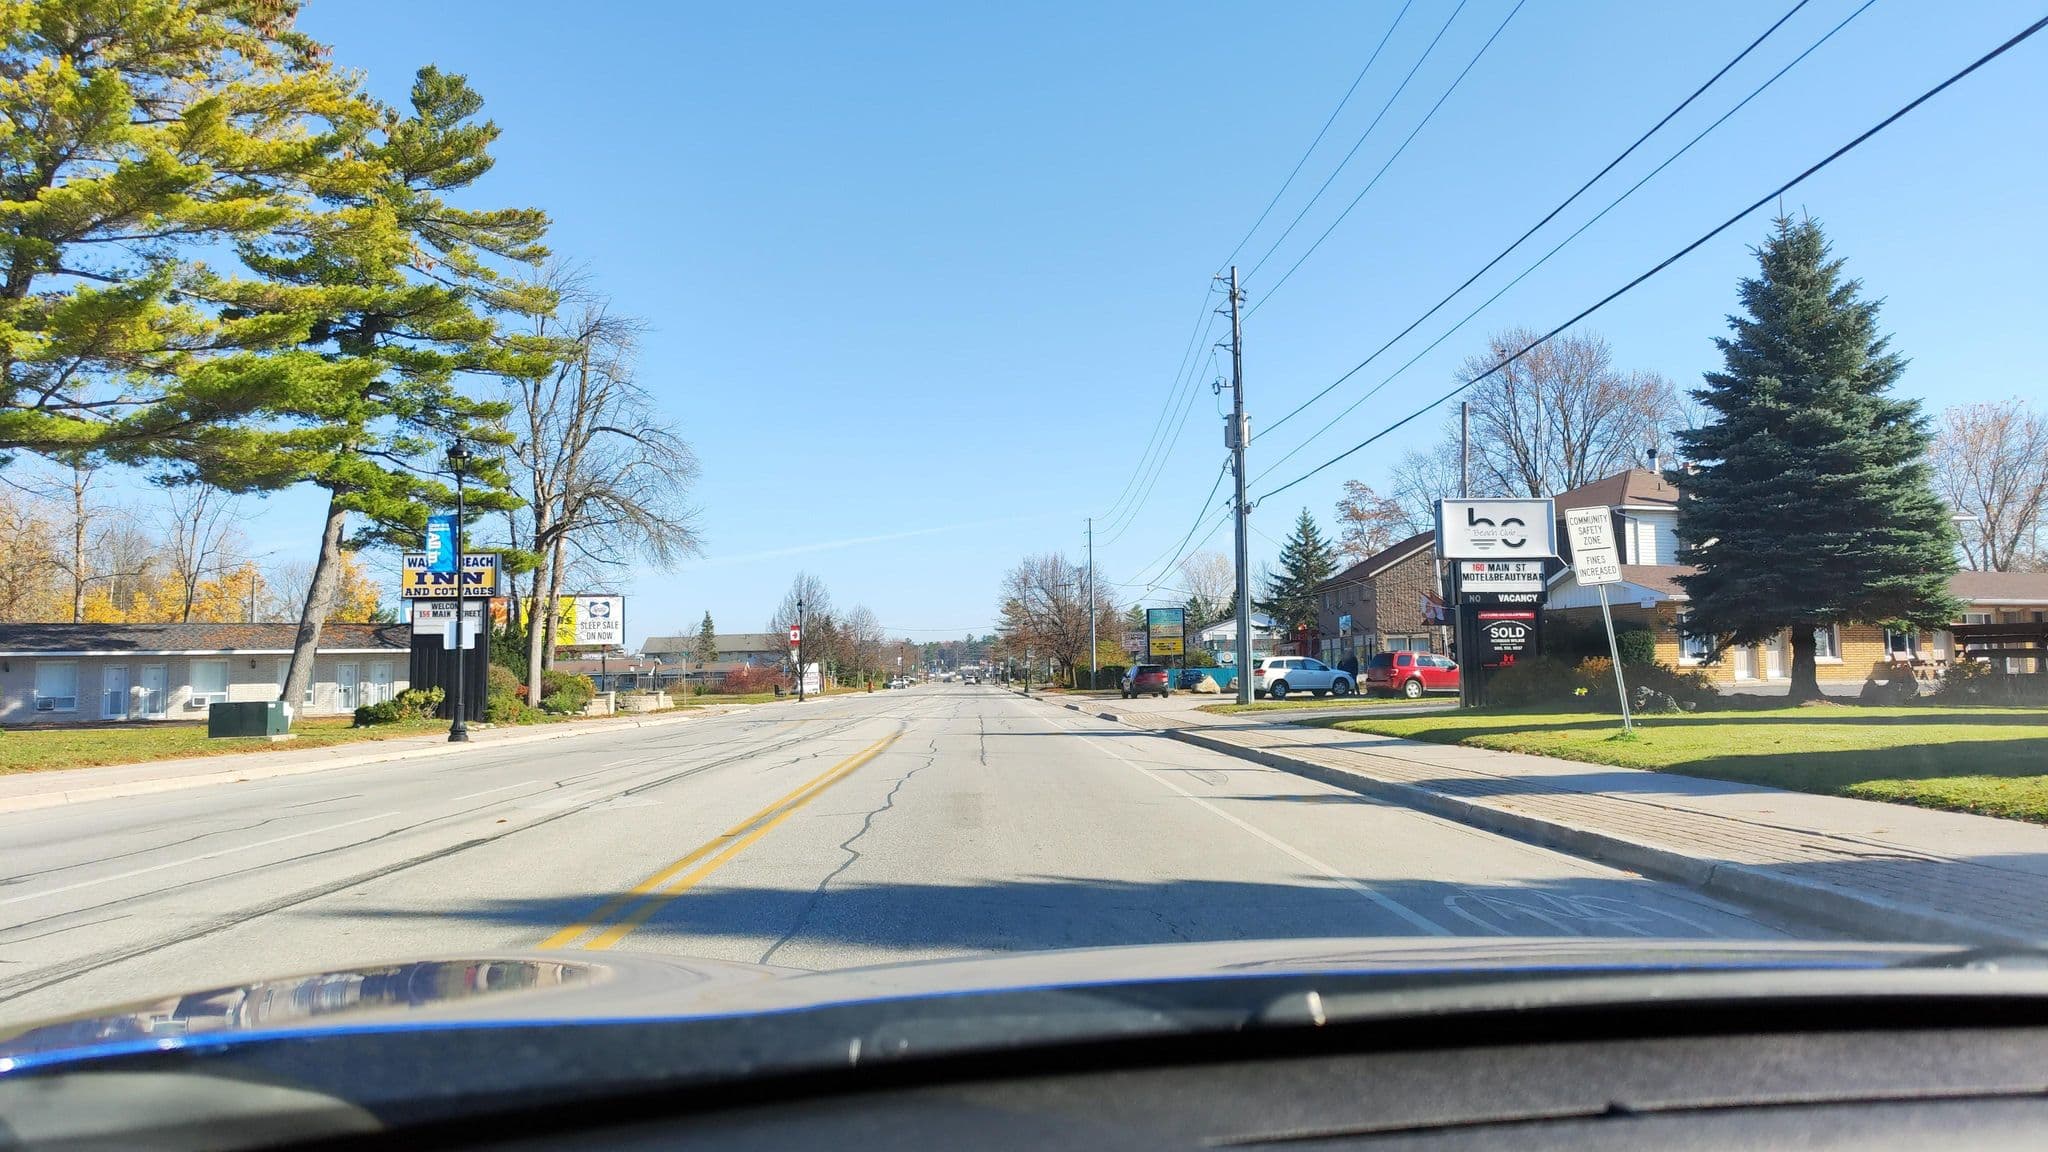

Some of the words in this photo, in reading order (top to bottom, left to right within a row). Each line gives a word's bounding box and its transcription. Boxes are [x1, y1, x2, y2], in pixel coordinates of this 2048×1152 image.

[1569, 514, 1608, 526] COMMUNITY
[1578, 525, 1603, 535] SAFETY
[1583, 535, 1602, 546] ZONE
[1586, 555, 1606, 565] FINES
[1472, 563, 1485, 572] 160
[1487, 563, 1510, 572] MAIN
[1515, 563, 1527, 572] ST
[1579, 565, 1617, 578] INCREASED
[415, 571, 485, 585] INN
[405, 587, 430, 596] AND
[434, 587, 495, 596] COTAGES
[1469, 594, 1481, 603] NO
[1498, 593, 1538, 603] VACANCY
[580, 621, 601, 630] SLEEP
[603, 620, 619, 630] SALE
[586, 631, 596, 641] ON
[597, 631, 613, 640] NOW
[1490, 627, 1525, 638] SOLD
